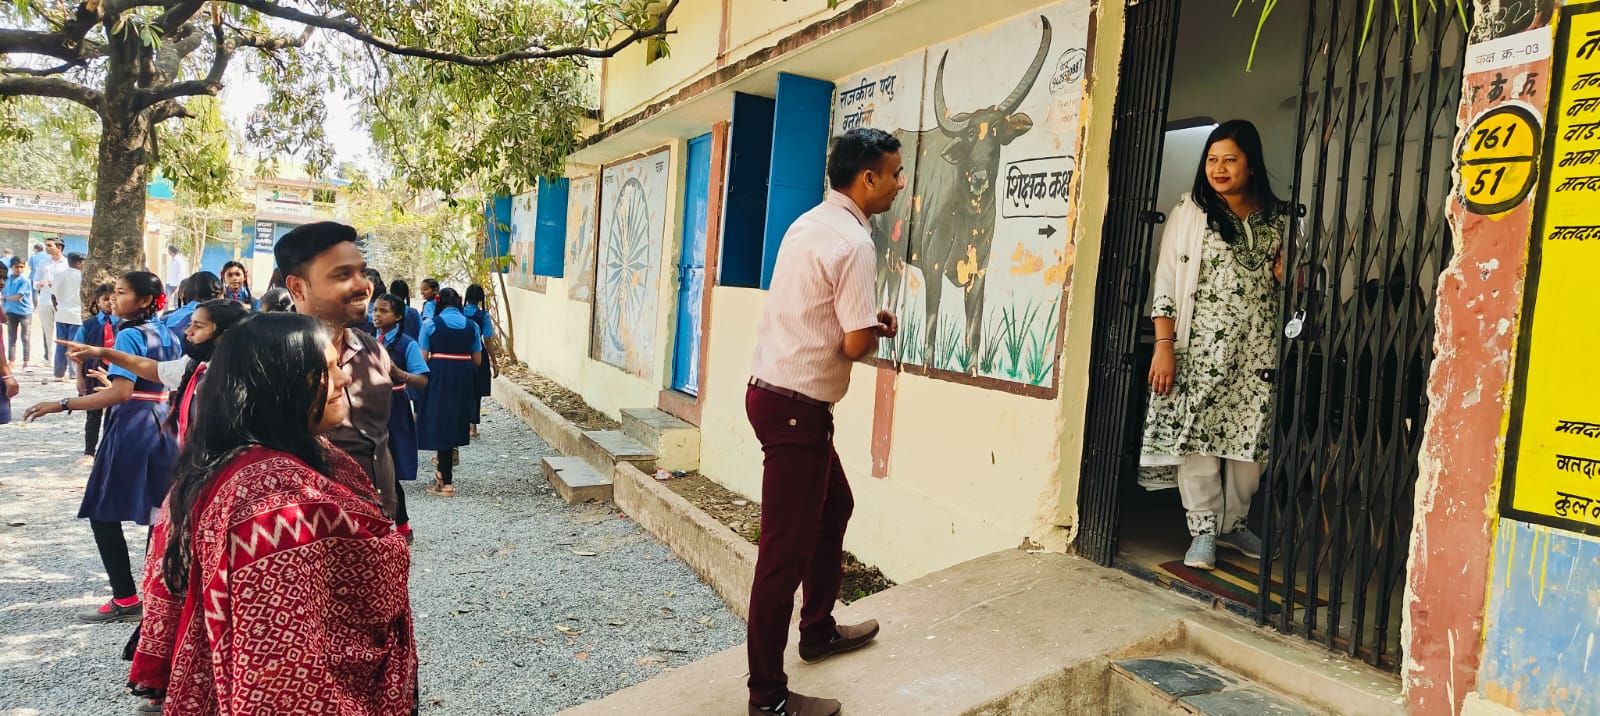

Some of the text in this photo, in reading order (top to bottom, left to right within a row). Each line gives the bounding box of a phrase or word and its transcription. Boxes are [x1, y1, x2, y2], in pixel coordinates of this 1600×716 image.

[1474, 52, 1496, 65] कक्ष
[840, 75, 897, 109] राजकीय पशु
[1473, 122, 1517, 153] 761
[1006, 165, 1047, 208] शिक्षक
[1470, 166, 1506, 197] 51
[1554, 490, 1594, 517] कुल
